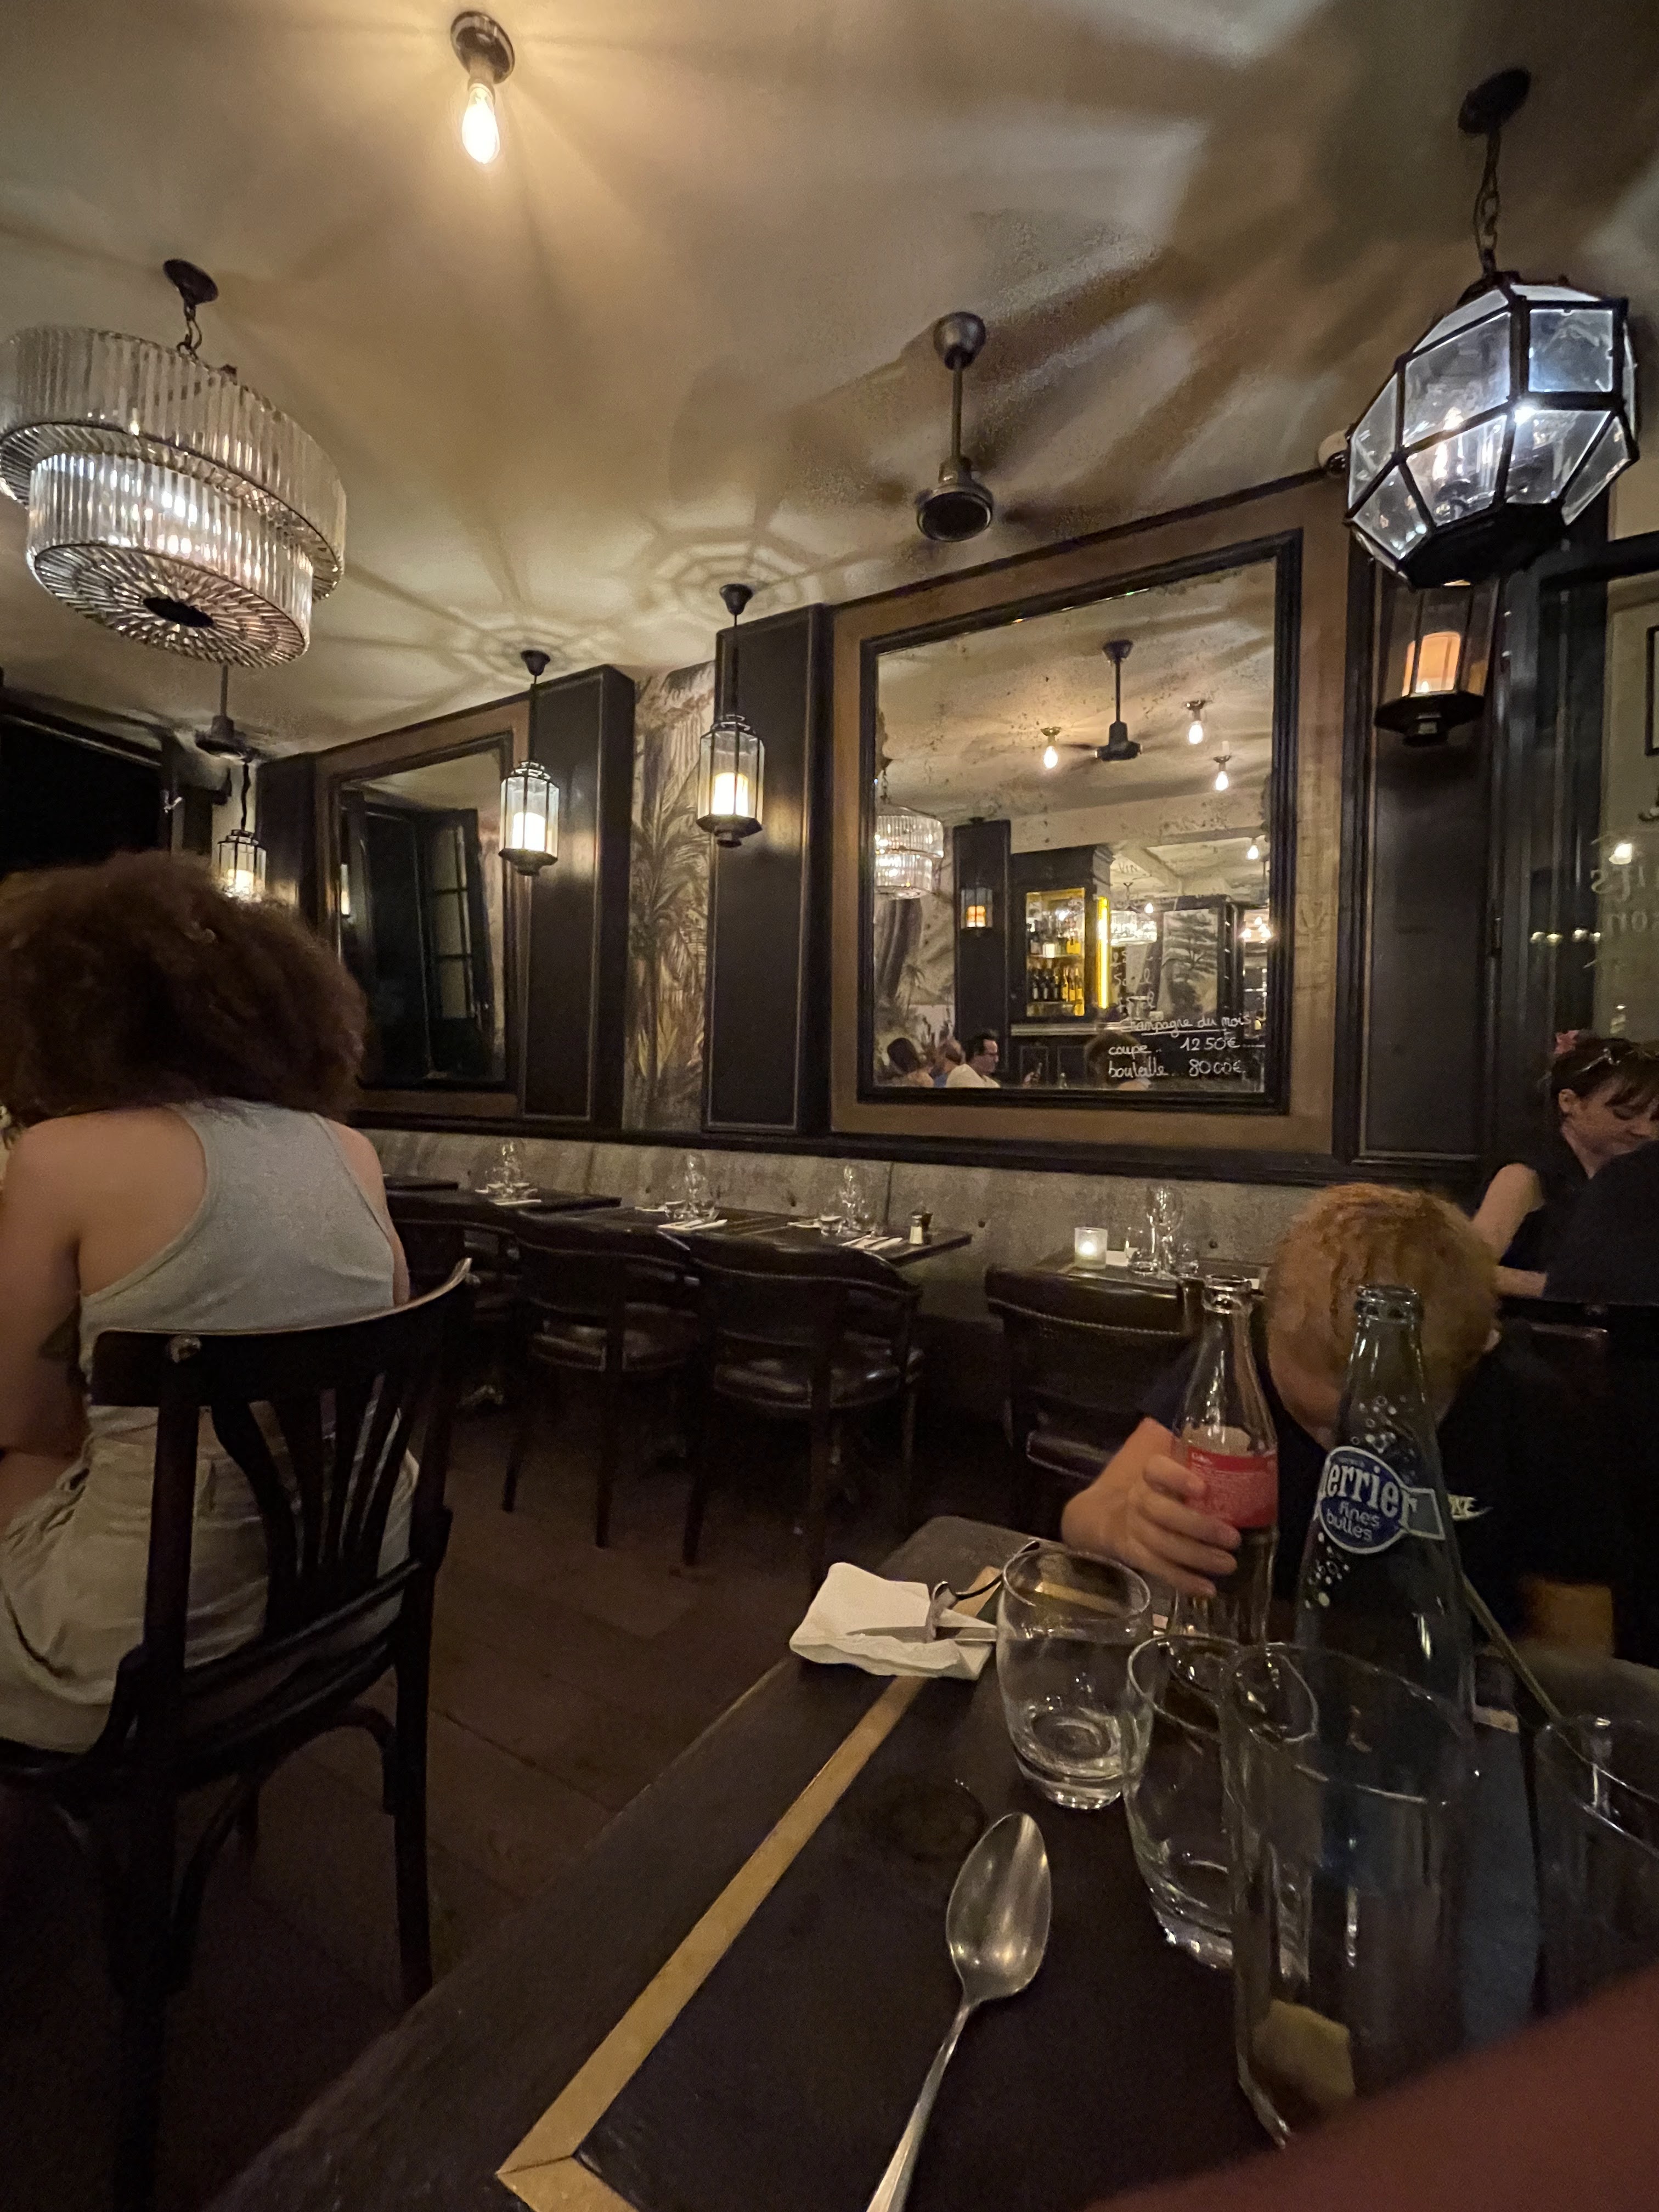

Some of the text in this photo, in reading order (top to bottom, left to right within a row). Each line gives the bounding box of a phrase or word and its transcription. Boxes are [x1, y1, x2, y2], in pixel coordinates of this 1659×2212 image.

[1197, 1015, 1217, 1028] du
[1221, 1013, 1252, 1028] mois
[1108, 1045, 1152, 1059] coupe
[1320, 1464, 1418, 1530] errier
